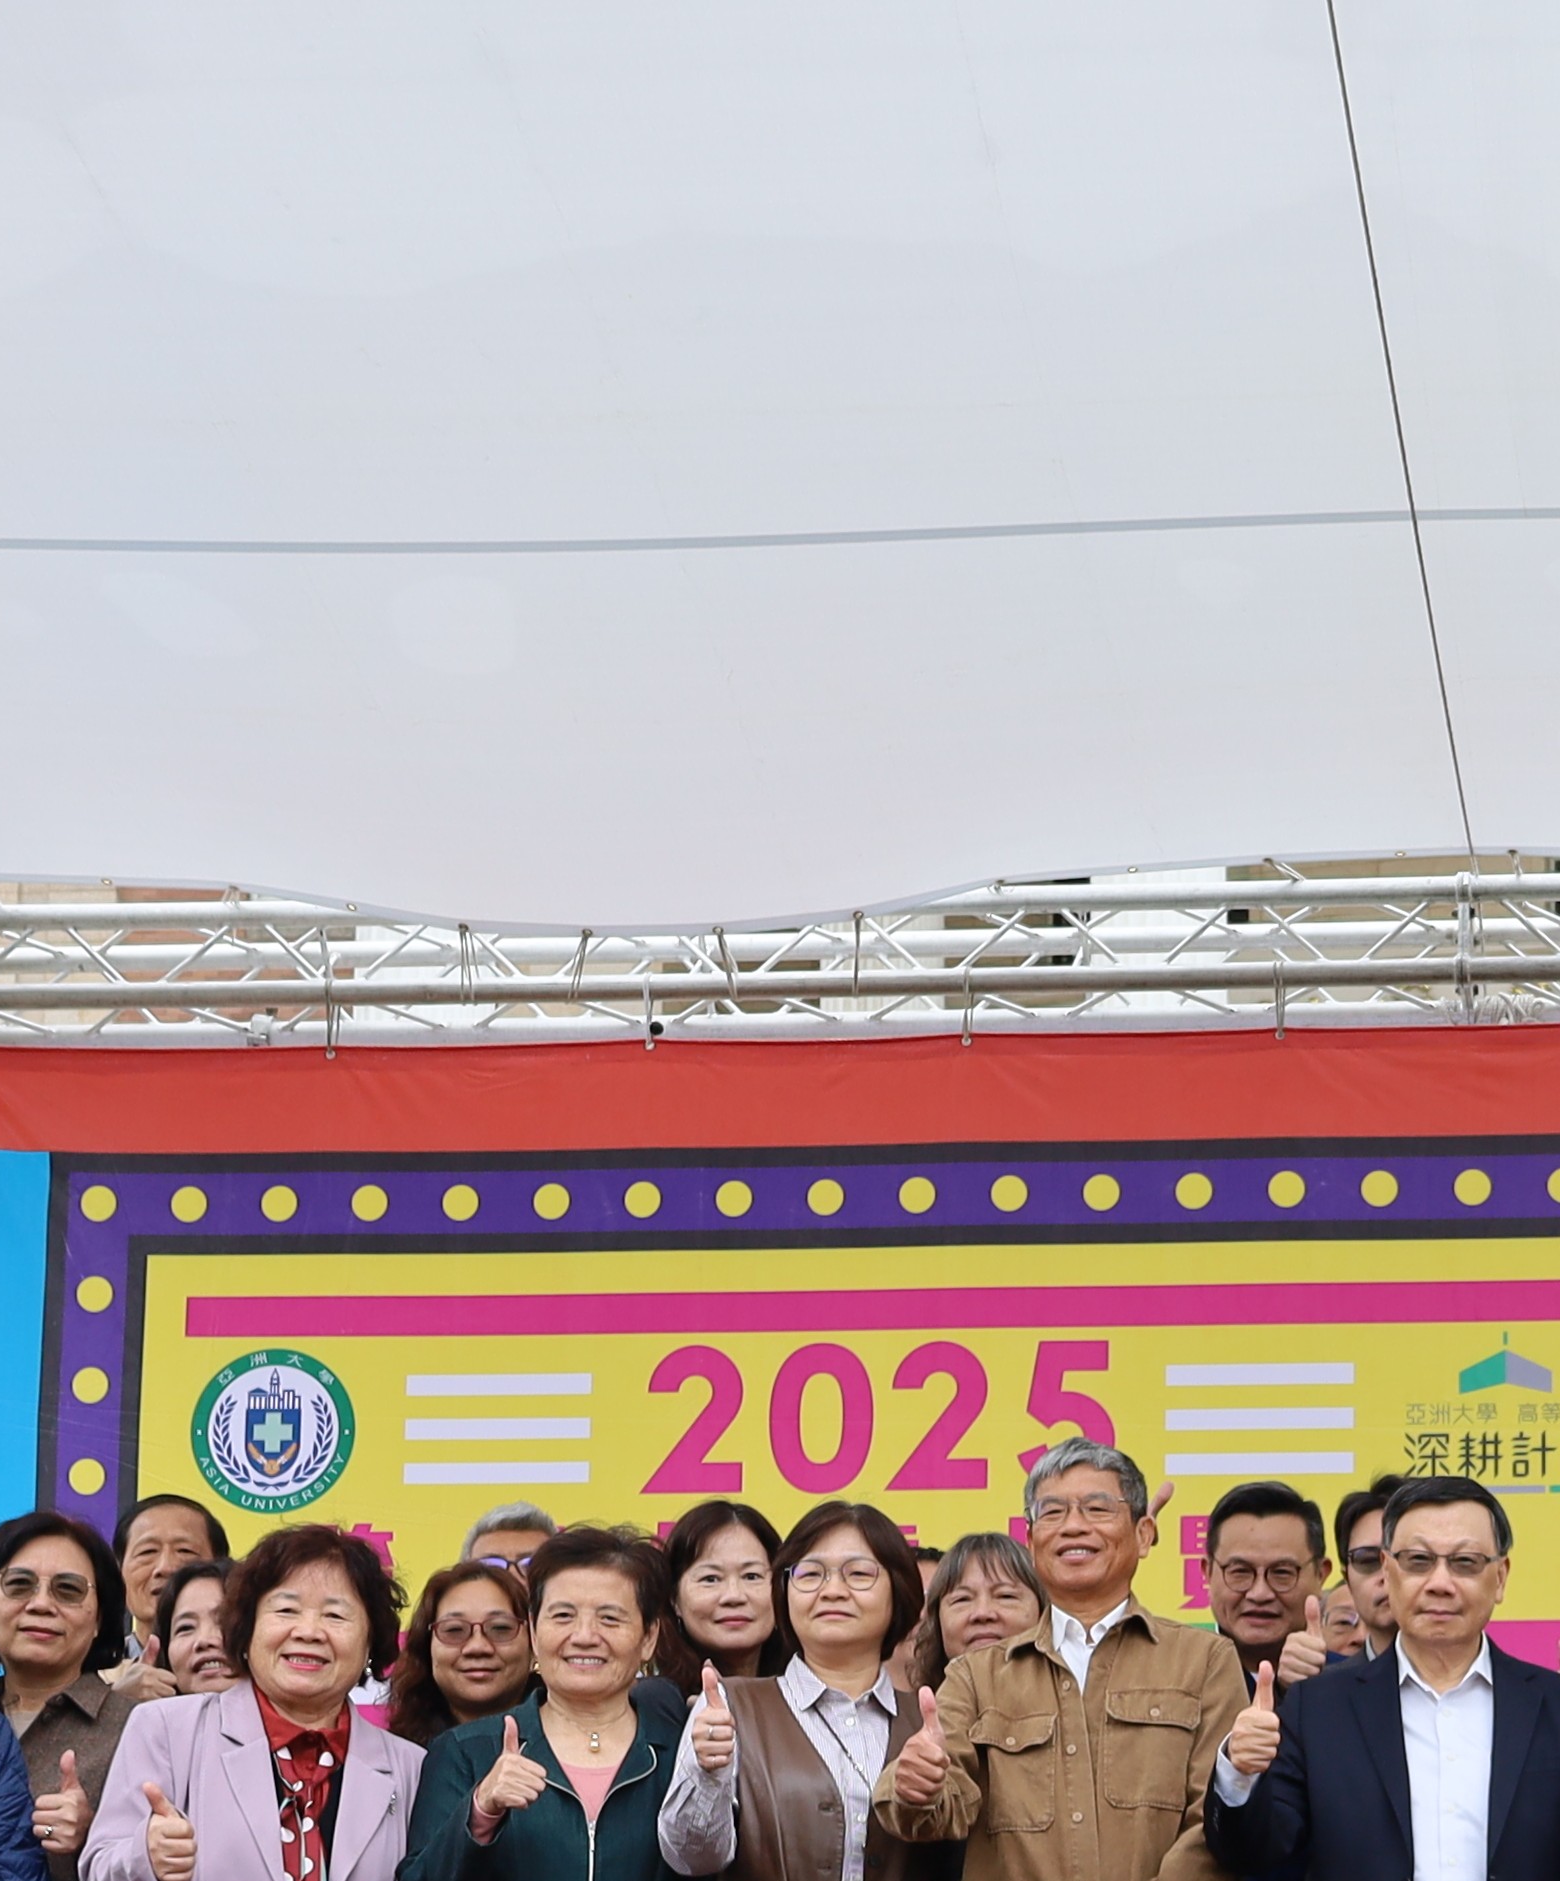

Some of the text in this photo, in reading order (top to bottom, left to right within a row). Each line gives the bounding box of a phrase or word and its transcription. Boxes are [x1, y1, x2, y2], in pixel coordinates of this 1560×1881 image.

[217, 1351, 336, 1386] 亞洲大學
[642, 1340, 1115, 1494] 2025
[1405, 1402, 1498, 1426] 亞洲大學
[199, 1453, 345, 1511] ASIA UNIVERSITY
